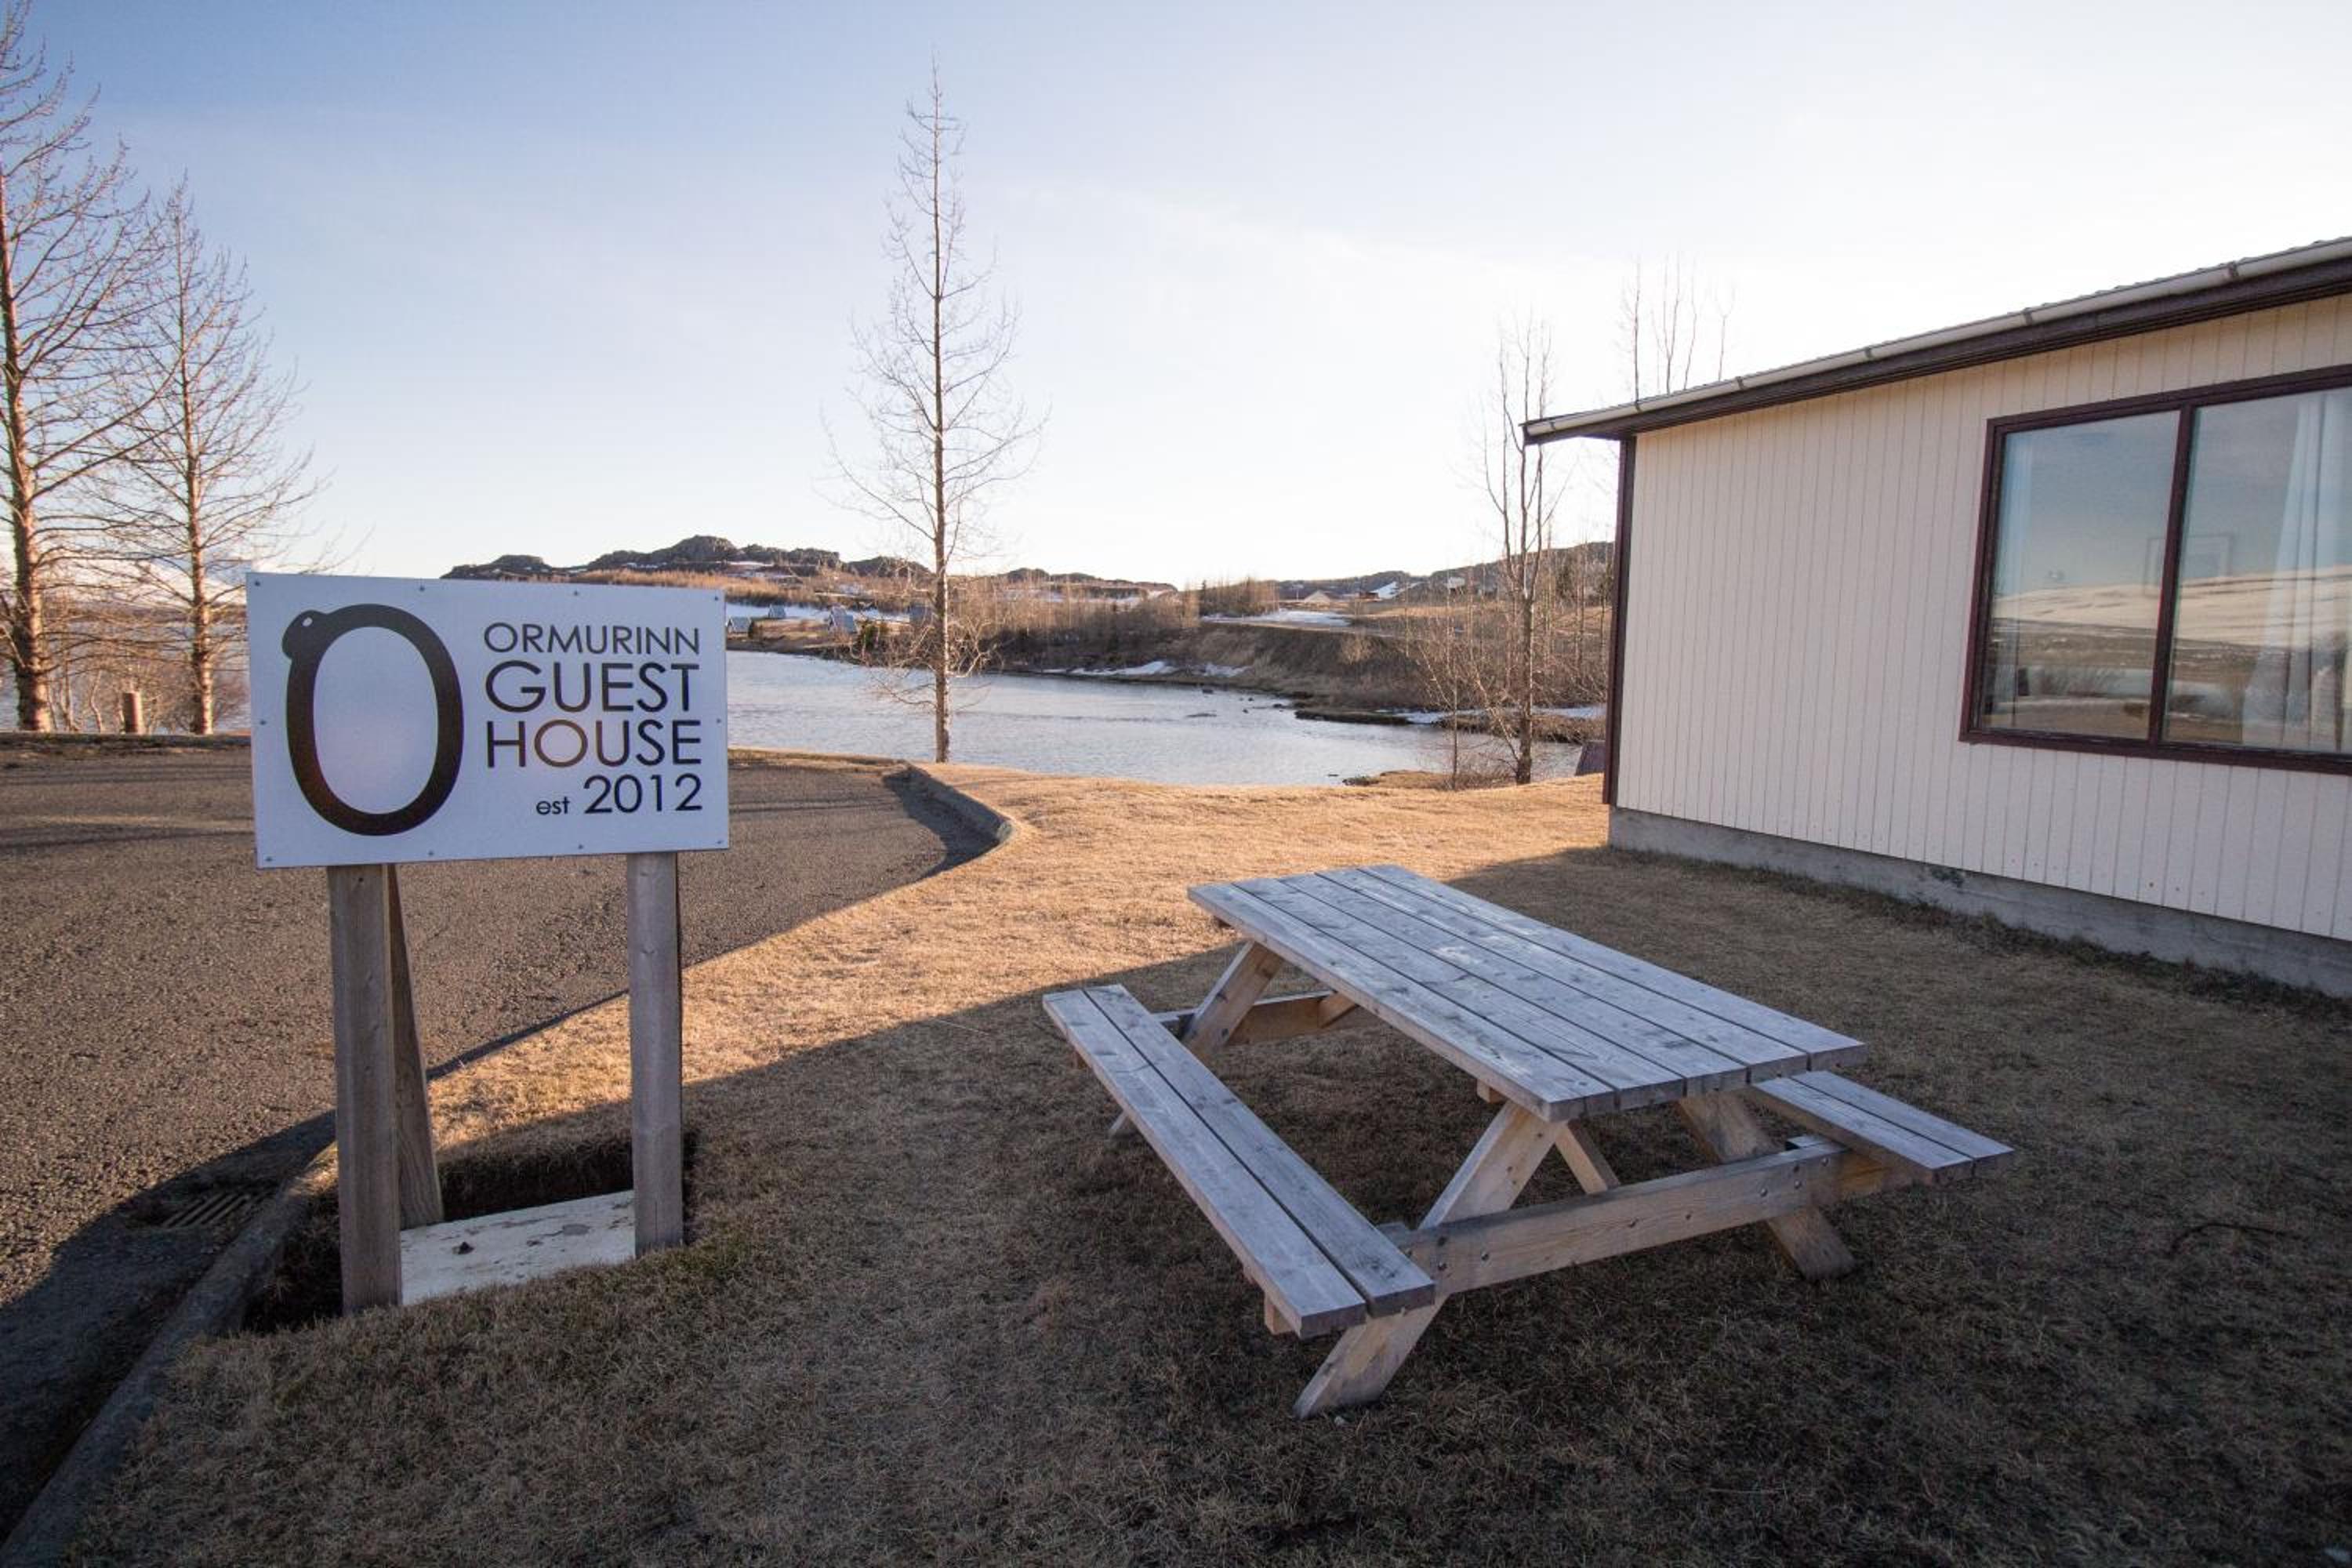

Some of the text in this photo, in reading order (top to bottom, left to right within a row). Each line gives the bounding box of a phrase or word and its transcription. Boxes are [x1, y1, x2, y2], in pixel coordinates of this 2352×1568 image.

[483, 622, 700, 655] ORMURINN
[485, 659, 700, 713] GUEST
[486, 718, 702, 769] HOUSE
[535, 772, 703, 816] est 2012
